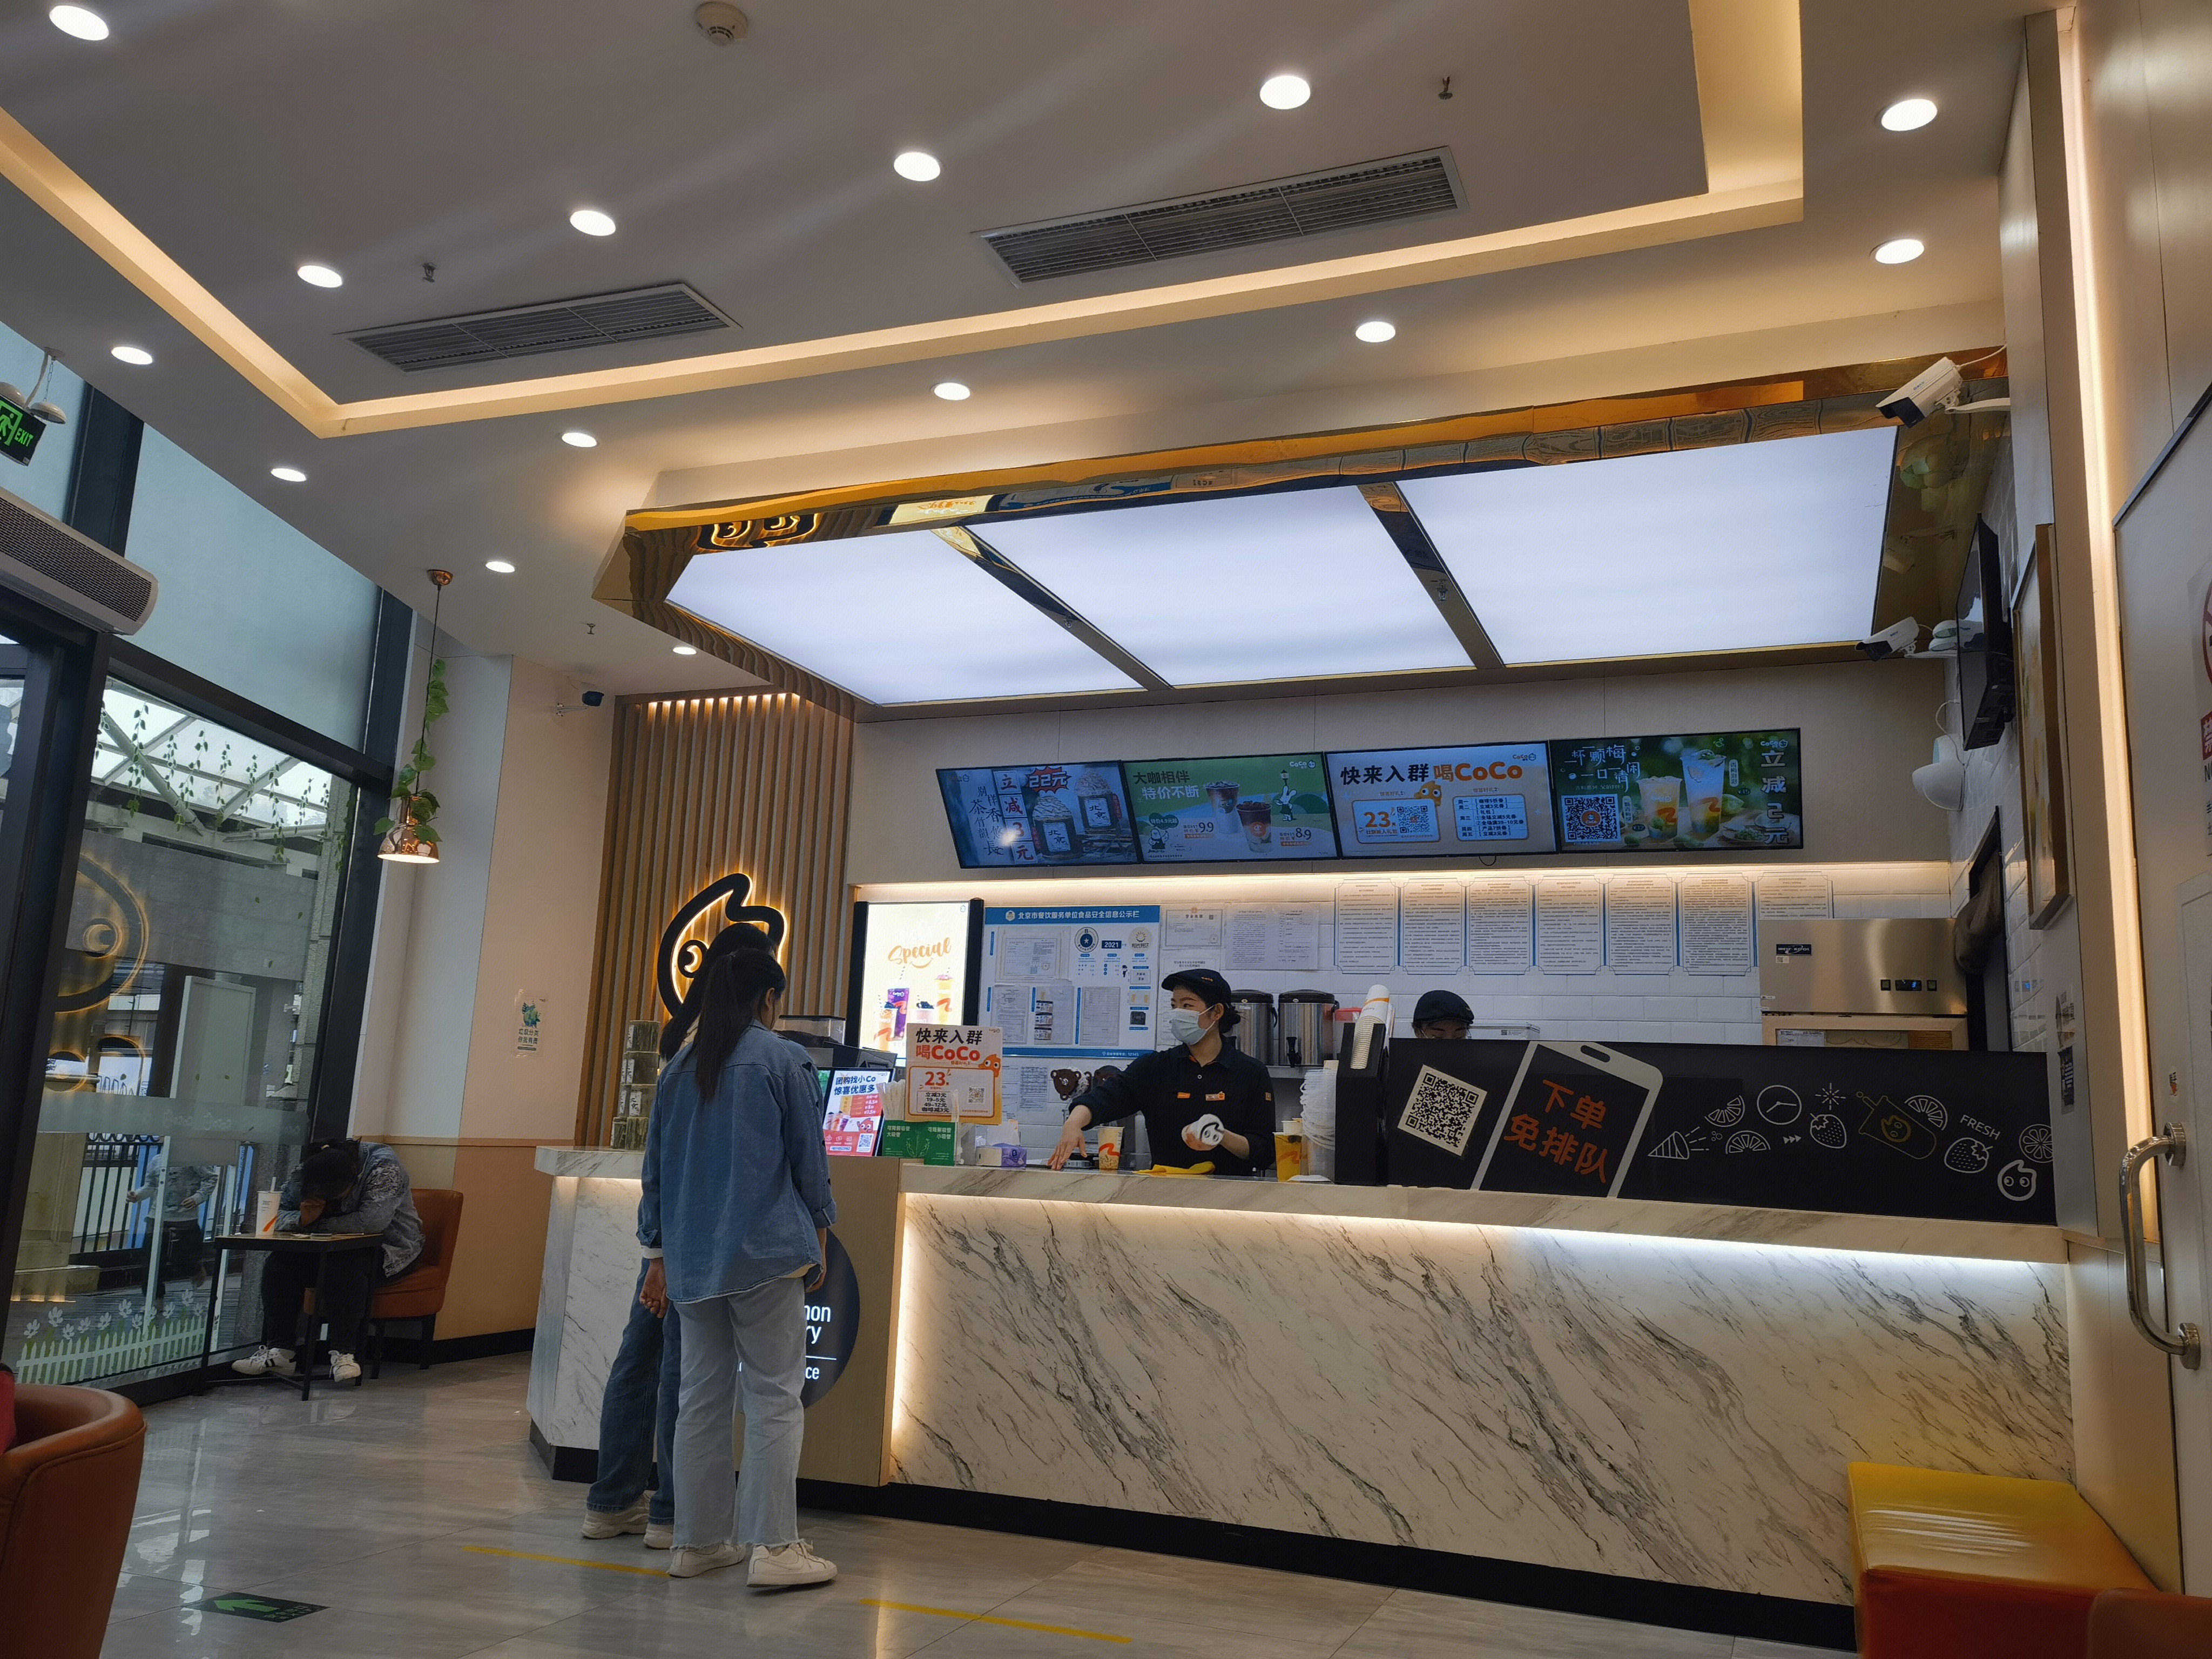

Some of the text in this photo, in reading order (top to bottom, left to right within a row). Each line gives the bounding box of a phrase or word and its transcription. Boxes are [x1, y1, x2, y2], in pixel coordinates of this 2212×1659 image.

[16, 427, 34, 447] EXIT
[1029, 771, 1068, 788] 22元
[1133, 770, 1190, 785] 大咖相伴
[1340, 761, 1523, 786] 快来入群喝CoCo
[1141, 785, 1199, 800] 特价不断
[1198, 822, 1214, 833] 9.9
[1364, 811, 1391, 828] 23
[1296, 827, 1312, 840] 8.9
[1018, 911, 1140, 920] 北京市餐饮服务单位食品安全信息公示栏
[887, 937, 952, 965] Special
[916, 1028, 983, 1046] 快来入群
[915, 1044, 981, 1061] 喝CoCo
[925, 1071, 946, 1087] 23
[834, 1084, 875, 1095] 惊喜优惠多
[1542, 1078, 1608, 1132] 下单
[1959, 1114, 2001, 1142] FRESH
[1506, 1115, 1613, 1185] 免排队
